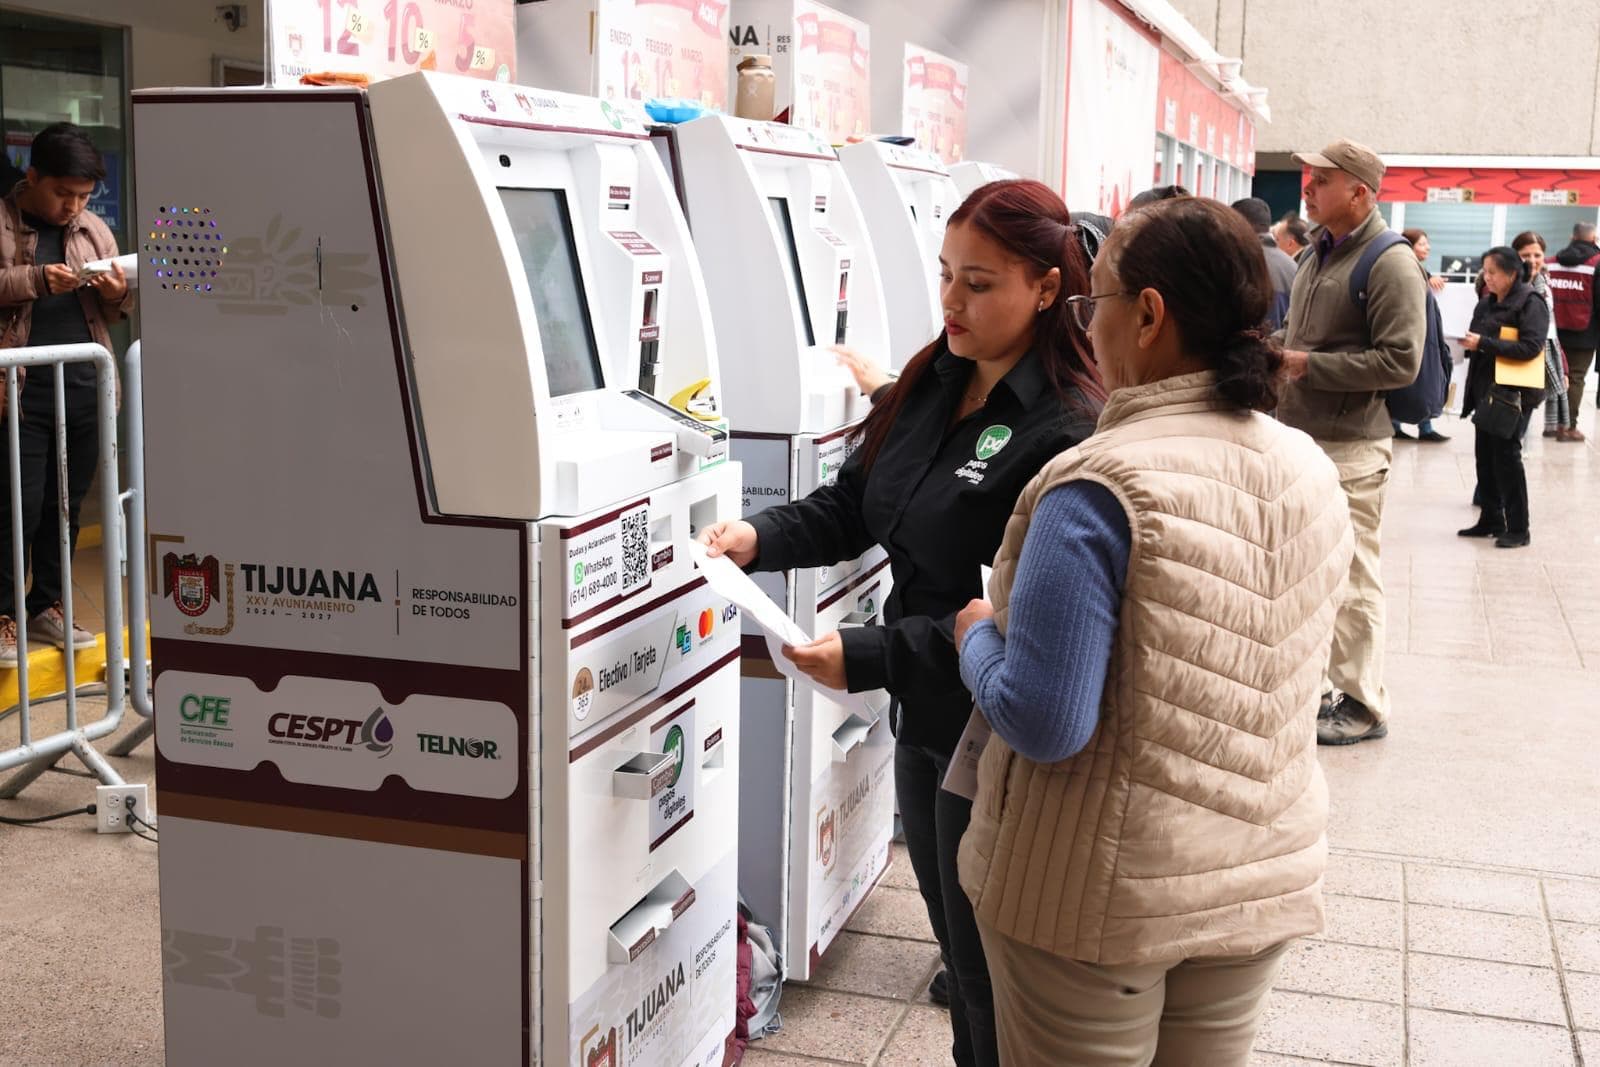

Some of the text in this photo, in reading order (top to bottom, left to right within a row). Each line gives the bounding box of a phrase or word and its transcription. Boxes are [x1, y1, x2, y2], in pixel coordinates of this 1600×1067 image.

[610, 28, 632, 47] ENERO
[584, 555, 613, 577] WhatsApp
[240, 563, 382, 603] TIJUANA
[246, 595, 356, 614] XXV AYUNTAMIENTO
[412, 588, 517, 607] RESPONSABILIDAD
[246, 607, 275, 616] 2024
[302, 612, 332, 620] 2027
[412, 604, 470, 619] DE TODOS
[599, 660, 628, 692] Efectivo
[633, 645, 657, 675] Tarjeta
[180, 695, 231, 725] CFE
[268, 713, 363, 744] CESPT
[417, 734, 497, 760] TELNOR
[626, 961, 685, 1044] TIJUANA
